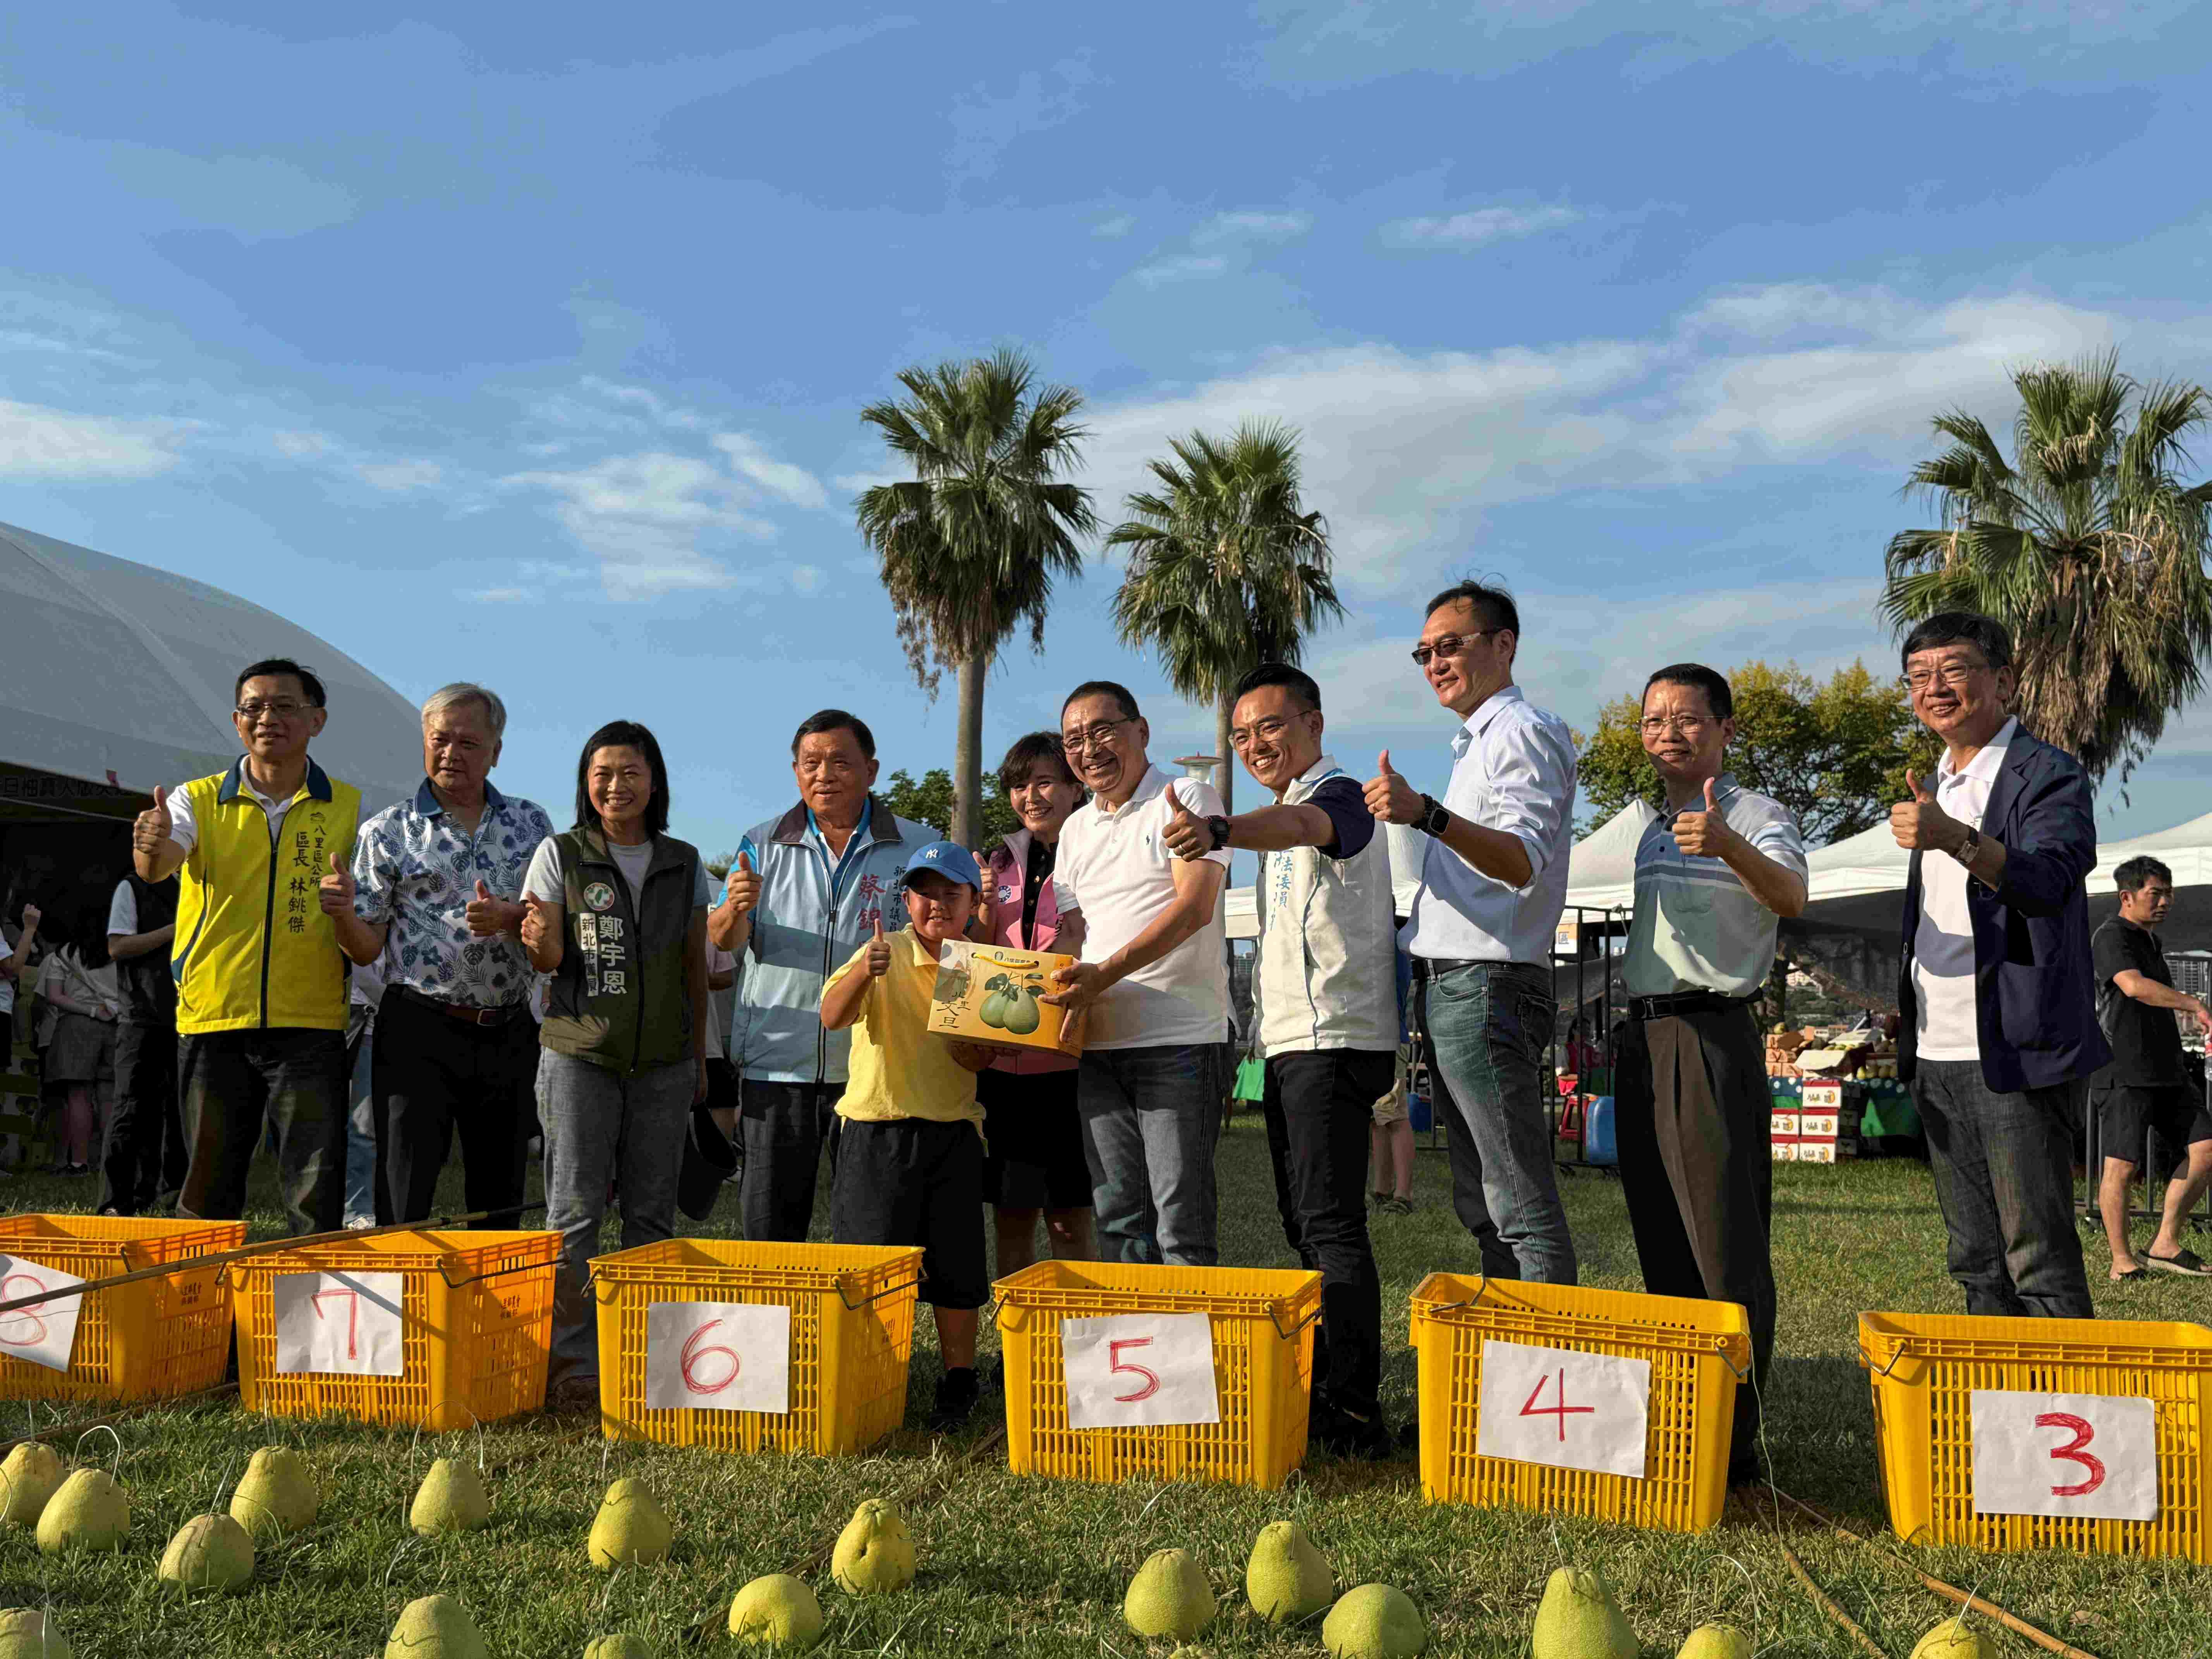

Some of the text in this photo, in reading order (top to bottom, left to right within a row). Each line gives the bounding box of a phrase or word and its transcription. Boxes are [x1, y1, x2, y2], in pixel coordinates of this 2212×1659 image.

[293, 831, 310, 867] 區長
[310, 825, 326, 889] 八里區公所
[1279, 850, 1294, 908] 法委員
[858, 873, 886, 948] 蔡錦
[599, 915, 627, 994] 鄭宇恩
[936, 1001, 960, 1029] 文旦
[0, 1275, 47, 1346] 8
[312, 1289, 357, 1360] 7
[681, 1319, 741, 1395] 6
[1107, 1336, 1160, 1402] 5
[1518, 1367, 1595, 1442] 4
[2035, 1412, 2106, 1497] 3
